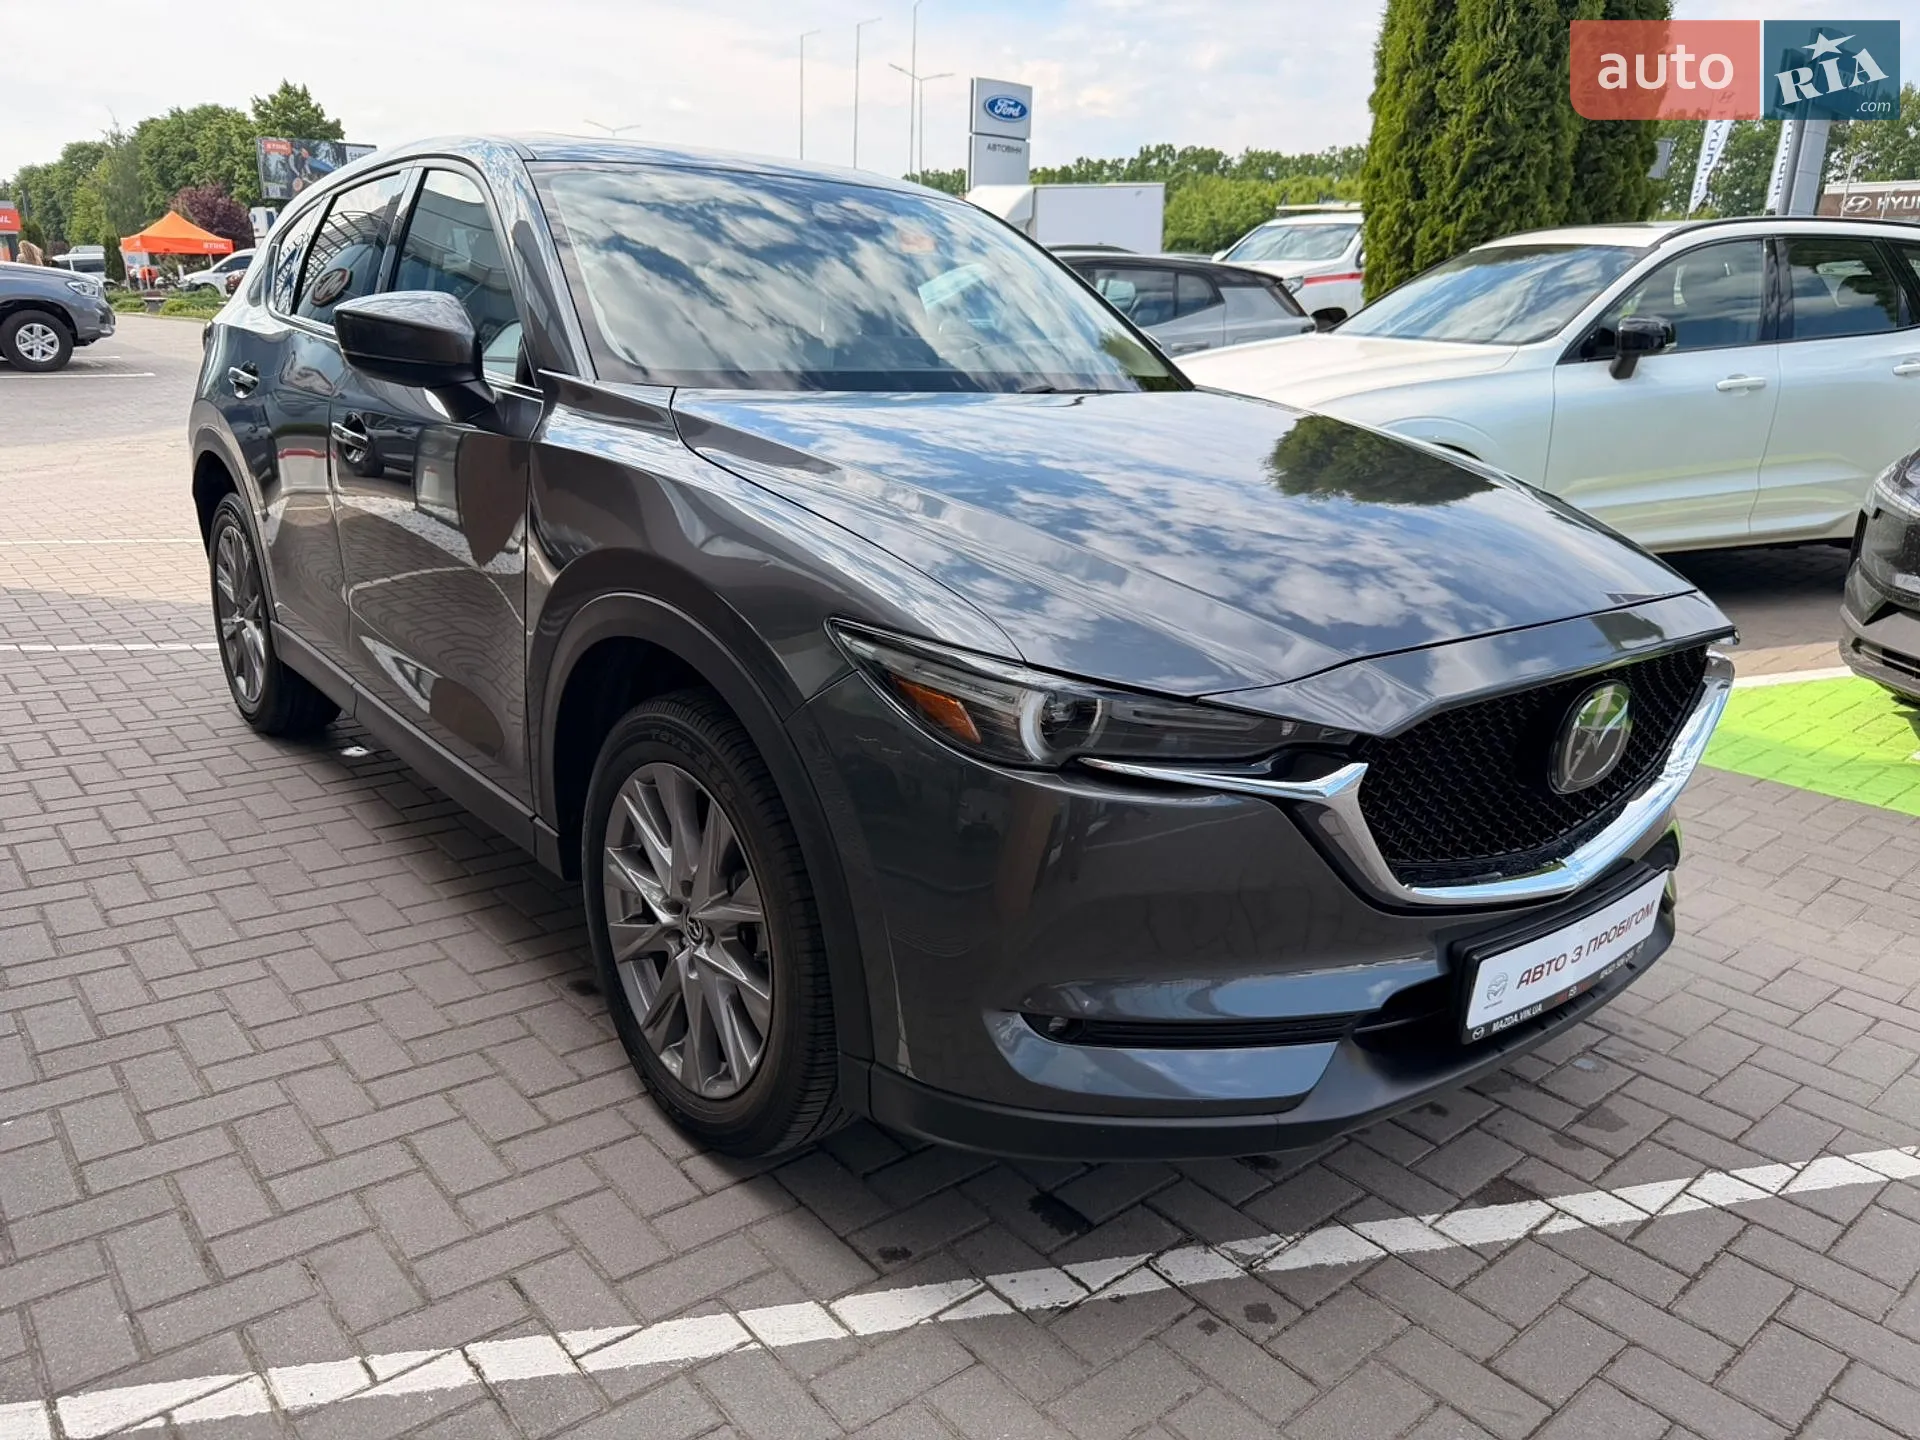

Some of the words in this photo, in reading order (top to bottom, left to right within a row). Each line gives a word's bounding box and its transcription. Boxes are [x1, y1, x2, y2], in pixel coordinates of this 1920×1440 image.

[994, 98, 1021, 117] Ford
[1516, 953, 1567, 990] АВТО
[1585, 898, 1655, 957] ПРОБІГОМ
